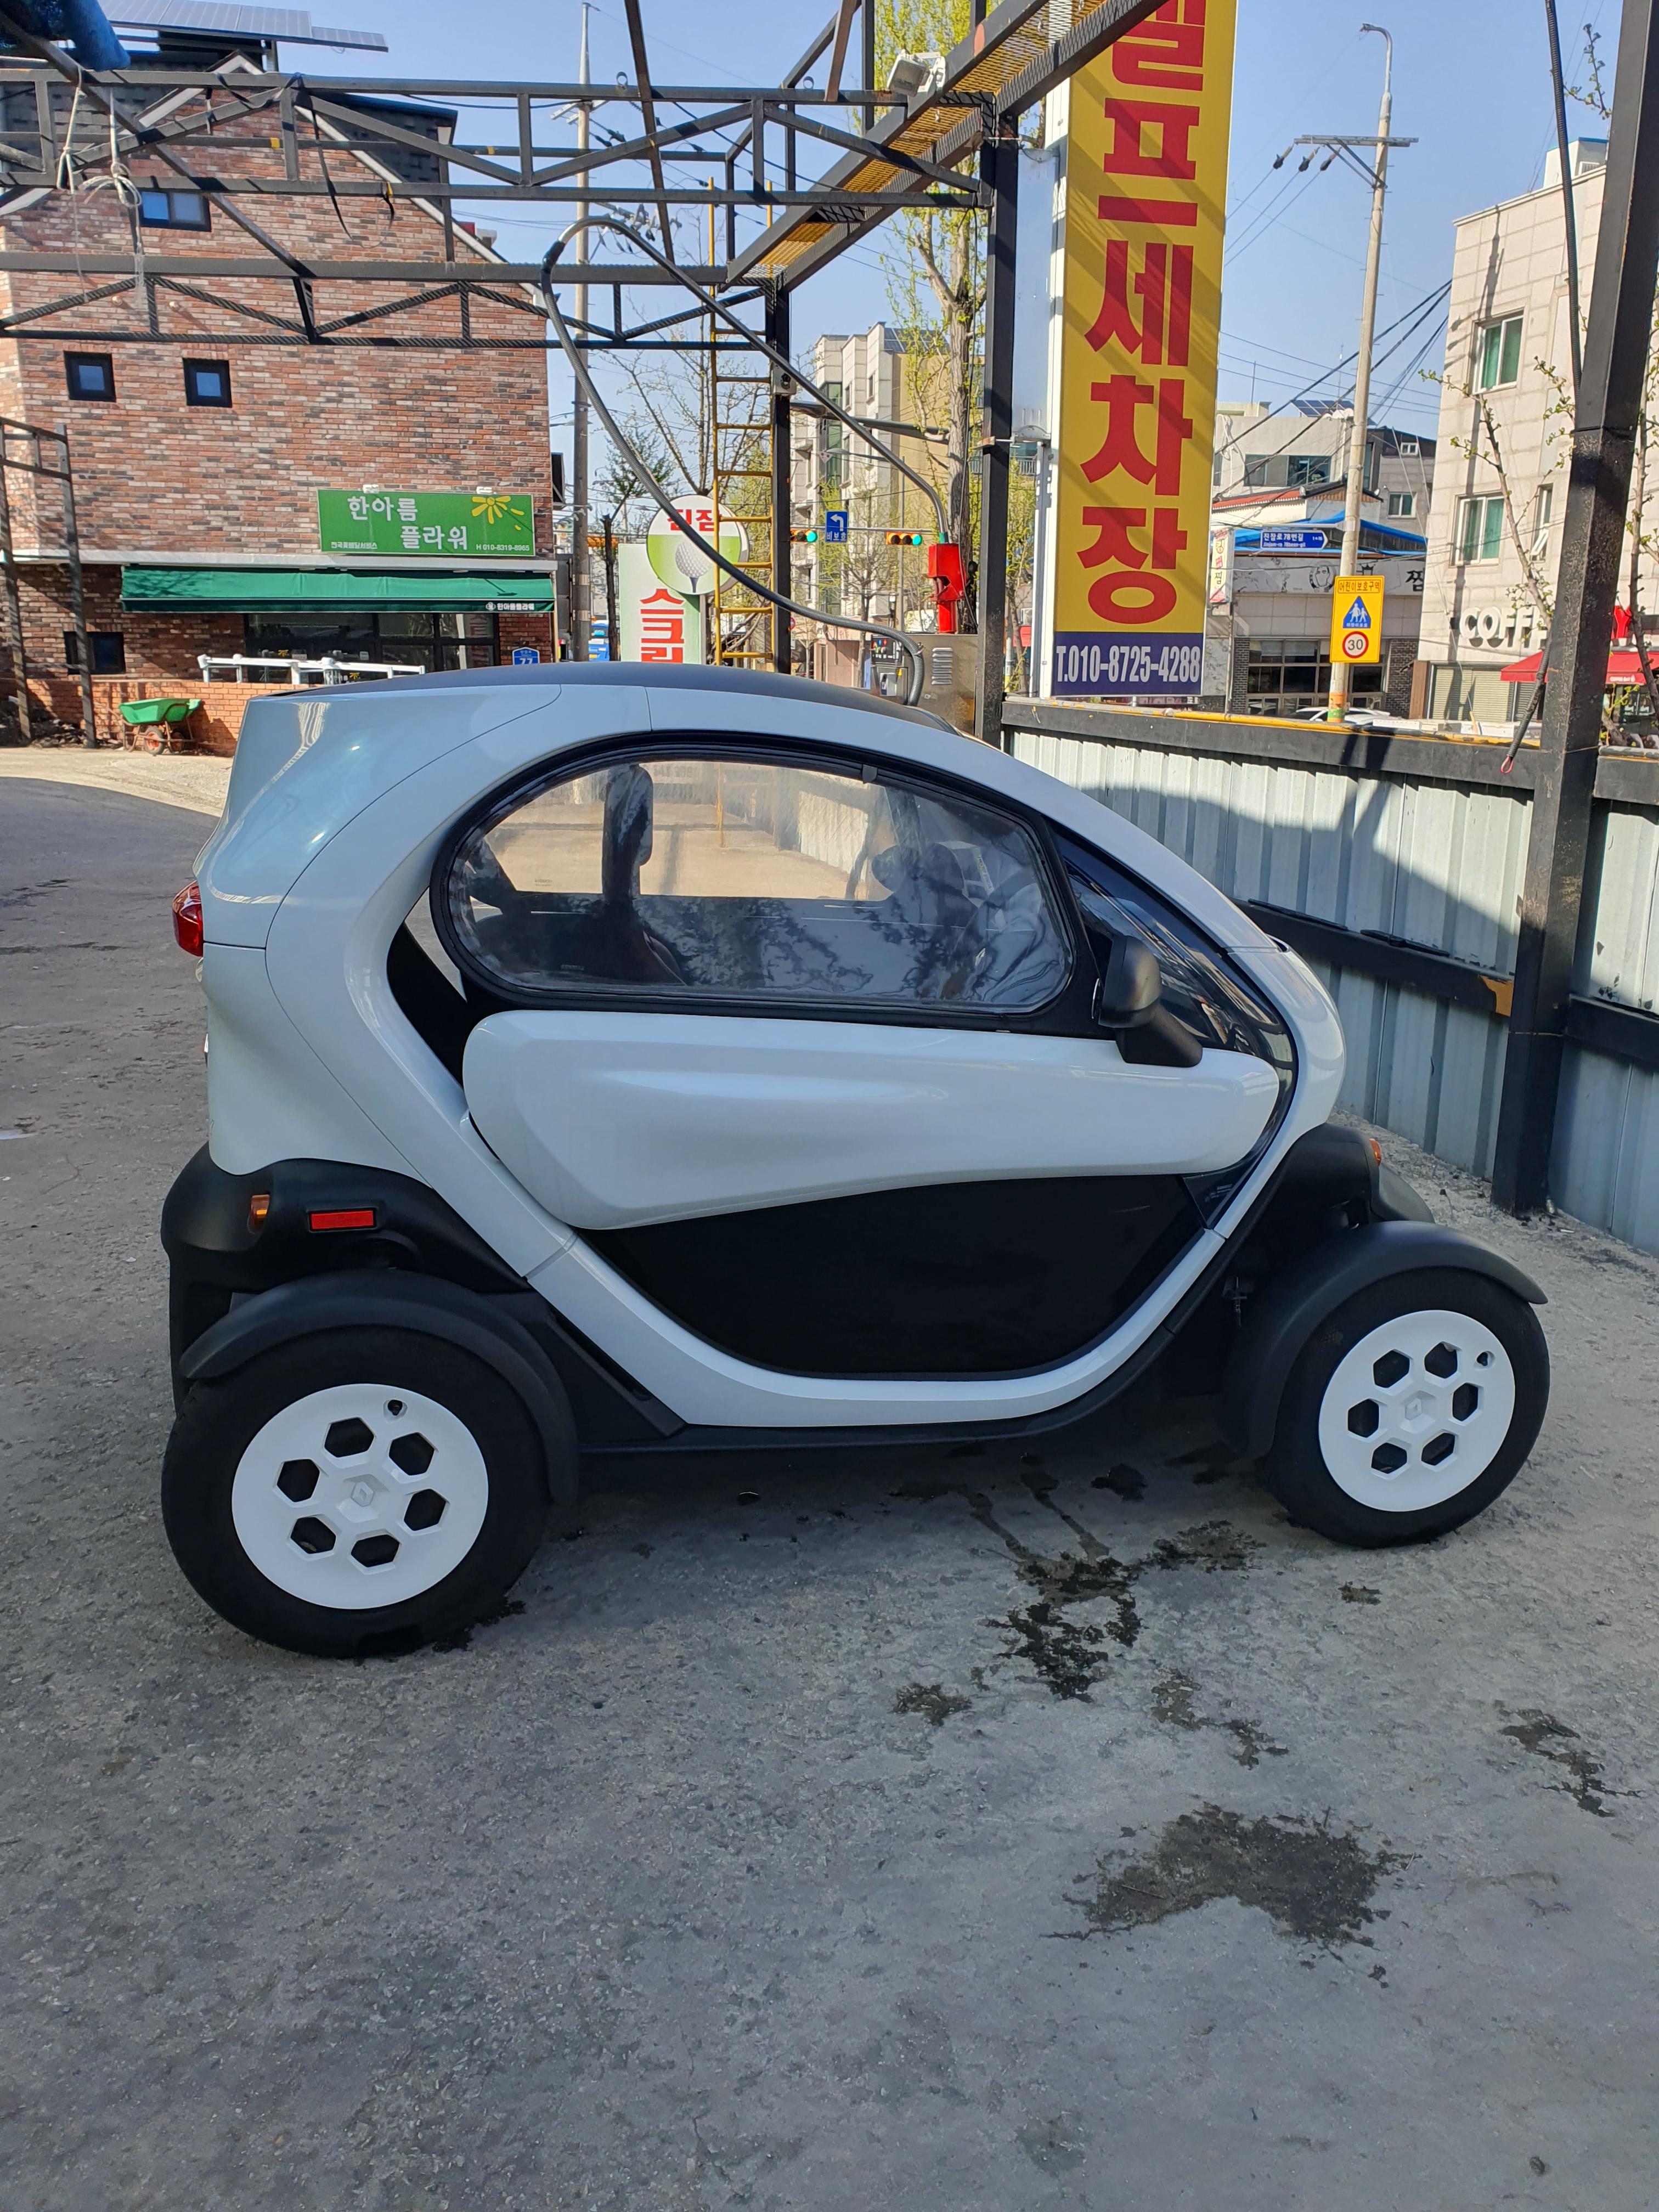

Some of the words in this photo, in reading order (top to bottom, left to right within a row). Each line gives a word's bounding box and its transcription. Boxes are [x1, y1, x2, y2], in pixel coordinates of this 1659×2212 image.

[347, 495, 418, 522] 한아름
[400, 525, 468, 550] 플라워
[826, 531, 846, 541] 비보호
[1339, 581, 1380, 592] 어린이보호구역
[1347, 639, 1364, 651] 30
[1056, 645, 1201, 682] T.010-8725-4288
